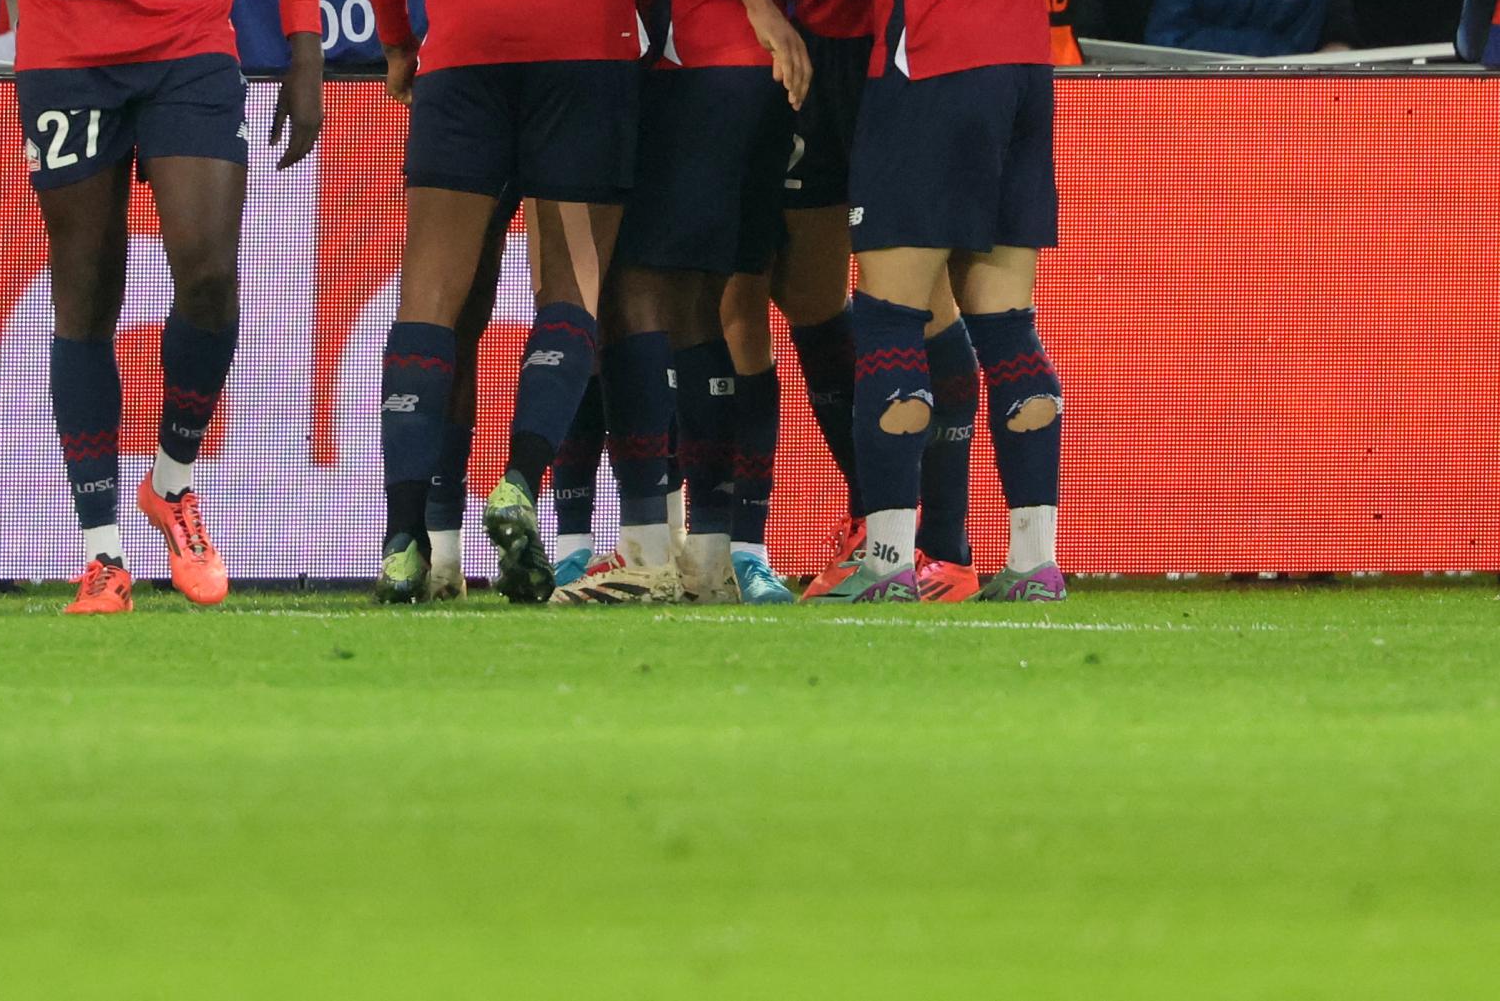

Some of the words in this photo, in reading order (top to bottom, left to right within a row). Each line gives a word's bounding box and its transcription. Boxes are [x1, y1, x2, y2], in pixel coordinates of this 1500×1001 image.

[36, 109, 102, 170] 27
[75, 477, 115, 494] LOSC
[872, 541, 900, 565] 316
